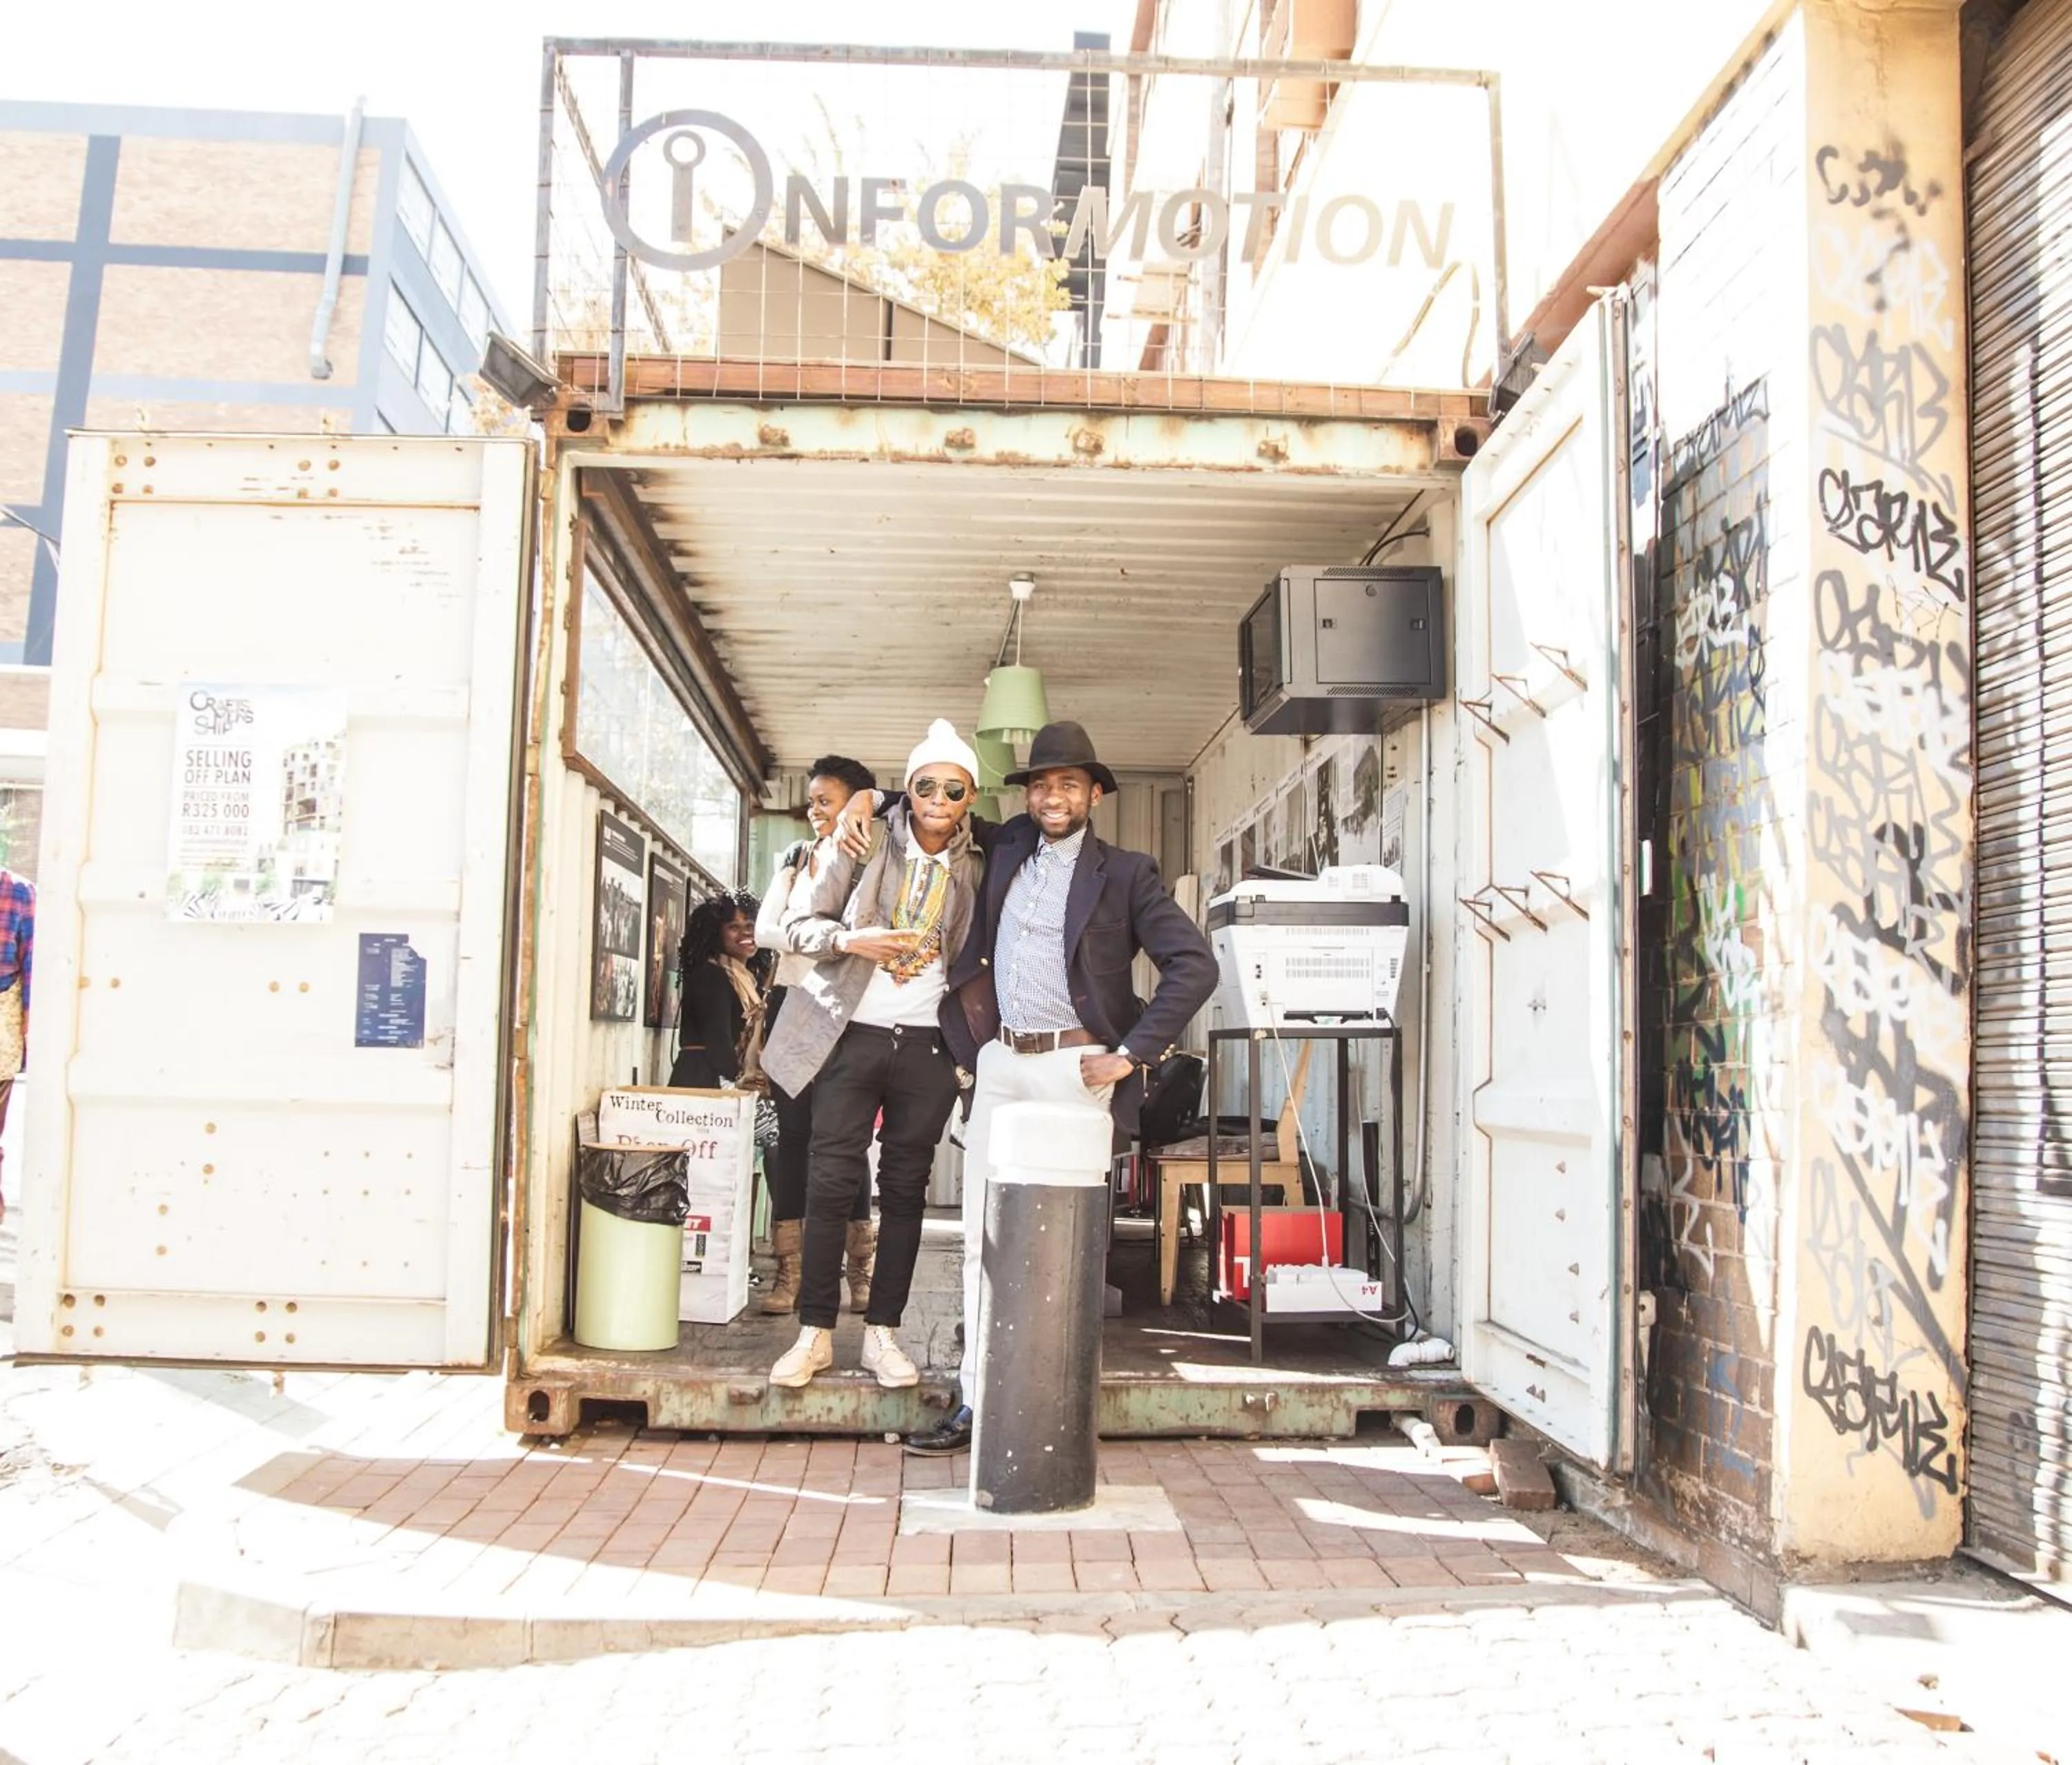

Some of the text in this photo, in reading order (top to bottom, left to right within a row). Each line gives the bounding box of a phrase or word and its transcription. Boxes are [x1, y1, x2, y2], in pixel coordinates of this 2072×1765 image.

[185, 749, 252, 769] SELLING
[184, 769, 251, 784] OFF PLAN
[182, 803, 249, 818] R325 000
[610, 1095, 662, 1111] Winter
[656, 1110, 733, 1128] Collection
[681, 1139, 718, 1159] Off
[1361, 1285, 1378, 1295] A4
